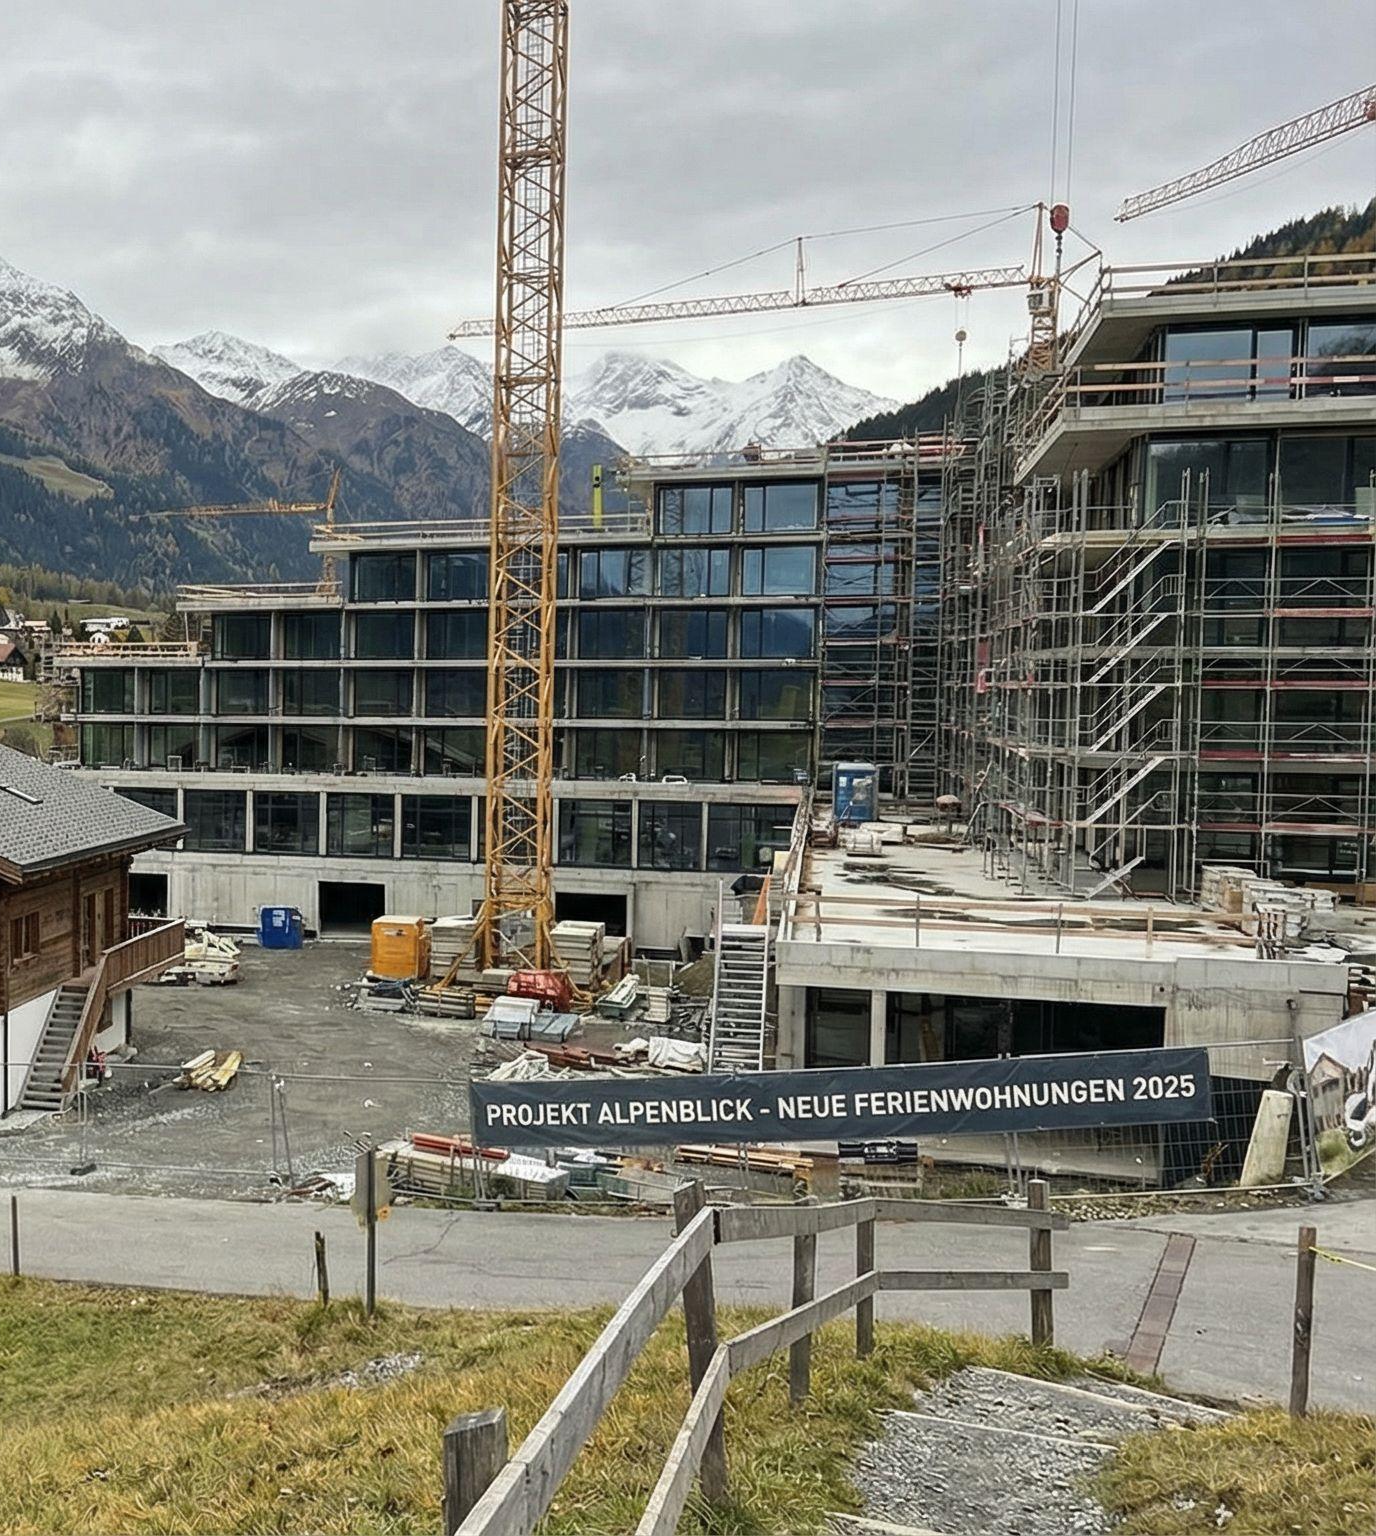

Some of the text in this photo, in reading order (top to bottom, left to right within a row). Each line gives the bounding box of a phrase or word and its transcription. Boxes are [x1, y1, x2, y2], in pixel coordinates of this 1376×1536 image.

[486, 1102, 592, 1126] PROJEKT
[597, 1098, 754, 1125] ALPENBLICK
[777, 1094, 848, 1119] NEUE
[853, 1078, 1125, 1116] FERIENWOHNUNGEN
[1132, 1074, 1196, 1100] 2025
